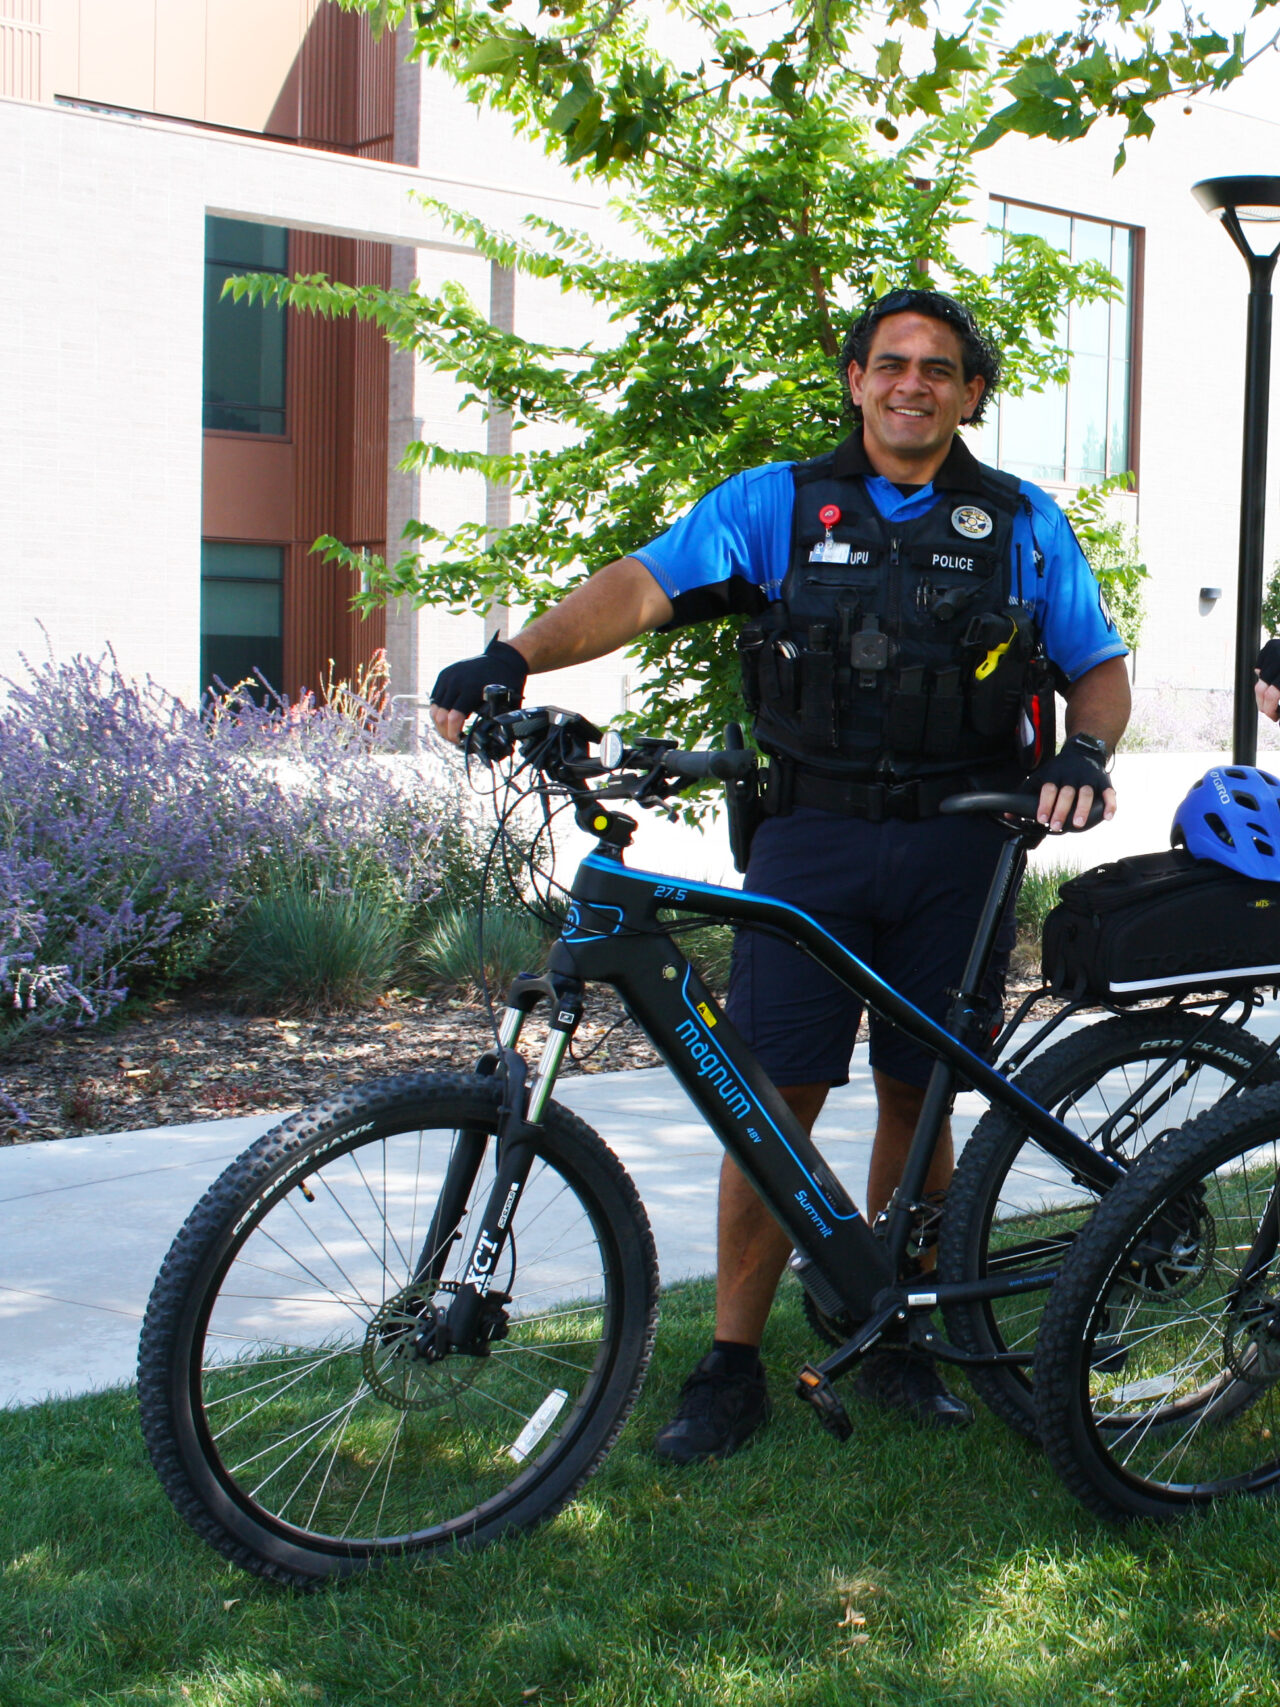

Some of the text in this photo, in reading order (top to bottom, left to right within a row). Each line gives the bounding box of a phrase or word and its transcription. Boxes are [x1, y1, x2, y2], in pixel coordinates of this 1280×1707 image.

[932, 554, 974, 571] POLICE
[1213, 778, 1231, 805] GIRO
[653, 885, 689, 901] 27.5
[1139, 1039, 1171, 1050] CST
[1171, 1039, 1214, 1052] RCK
[675, 1019, 751, 1120] magnum
[313, 1121, 376, 1157] HAWK
[746, 1127, 762, 1143] 48V
[794, 1190, 833, 1238] Summit
[465, 1229, 499, 1295] XCT
